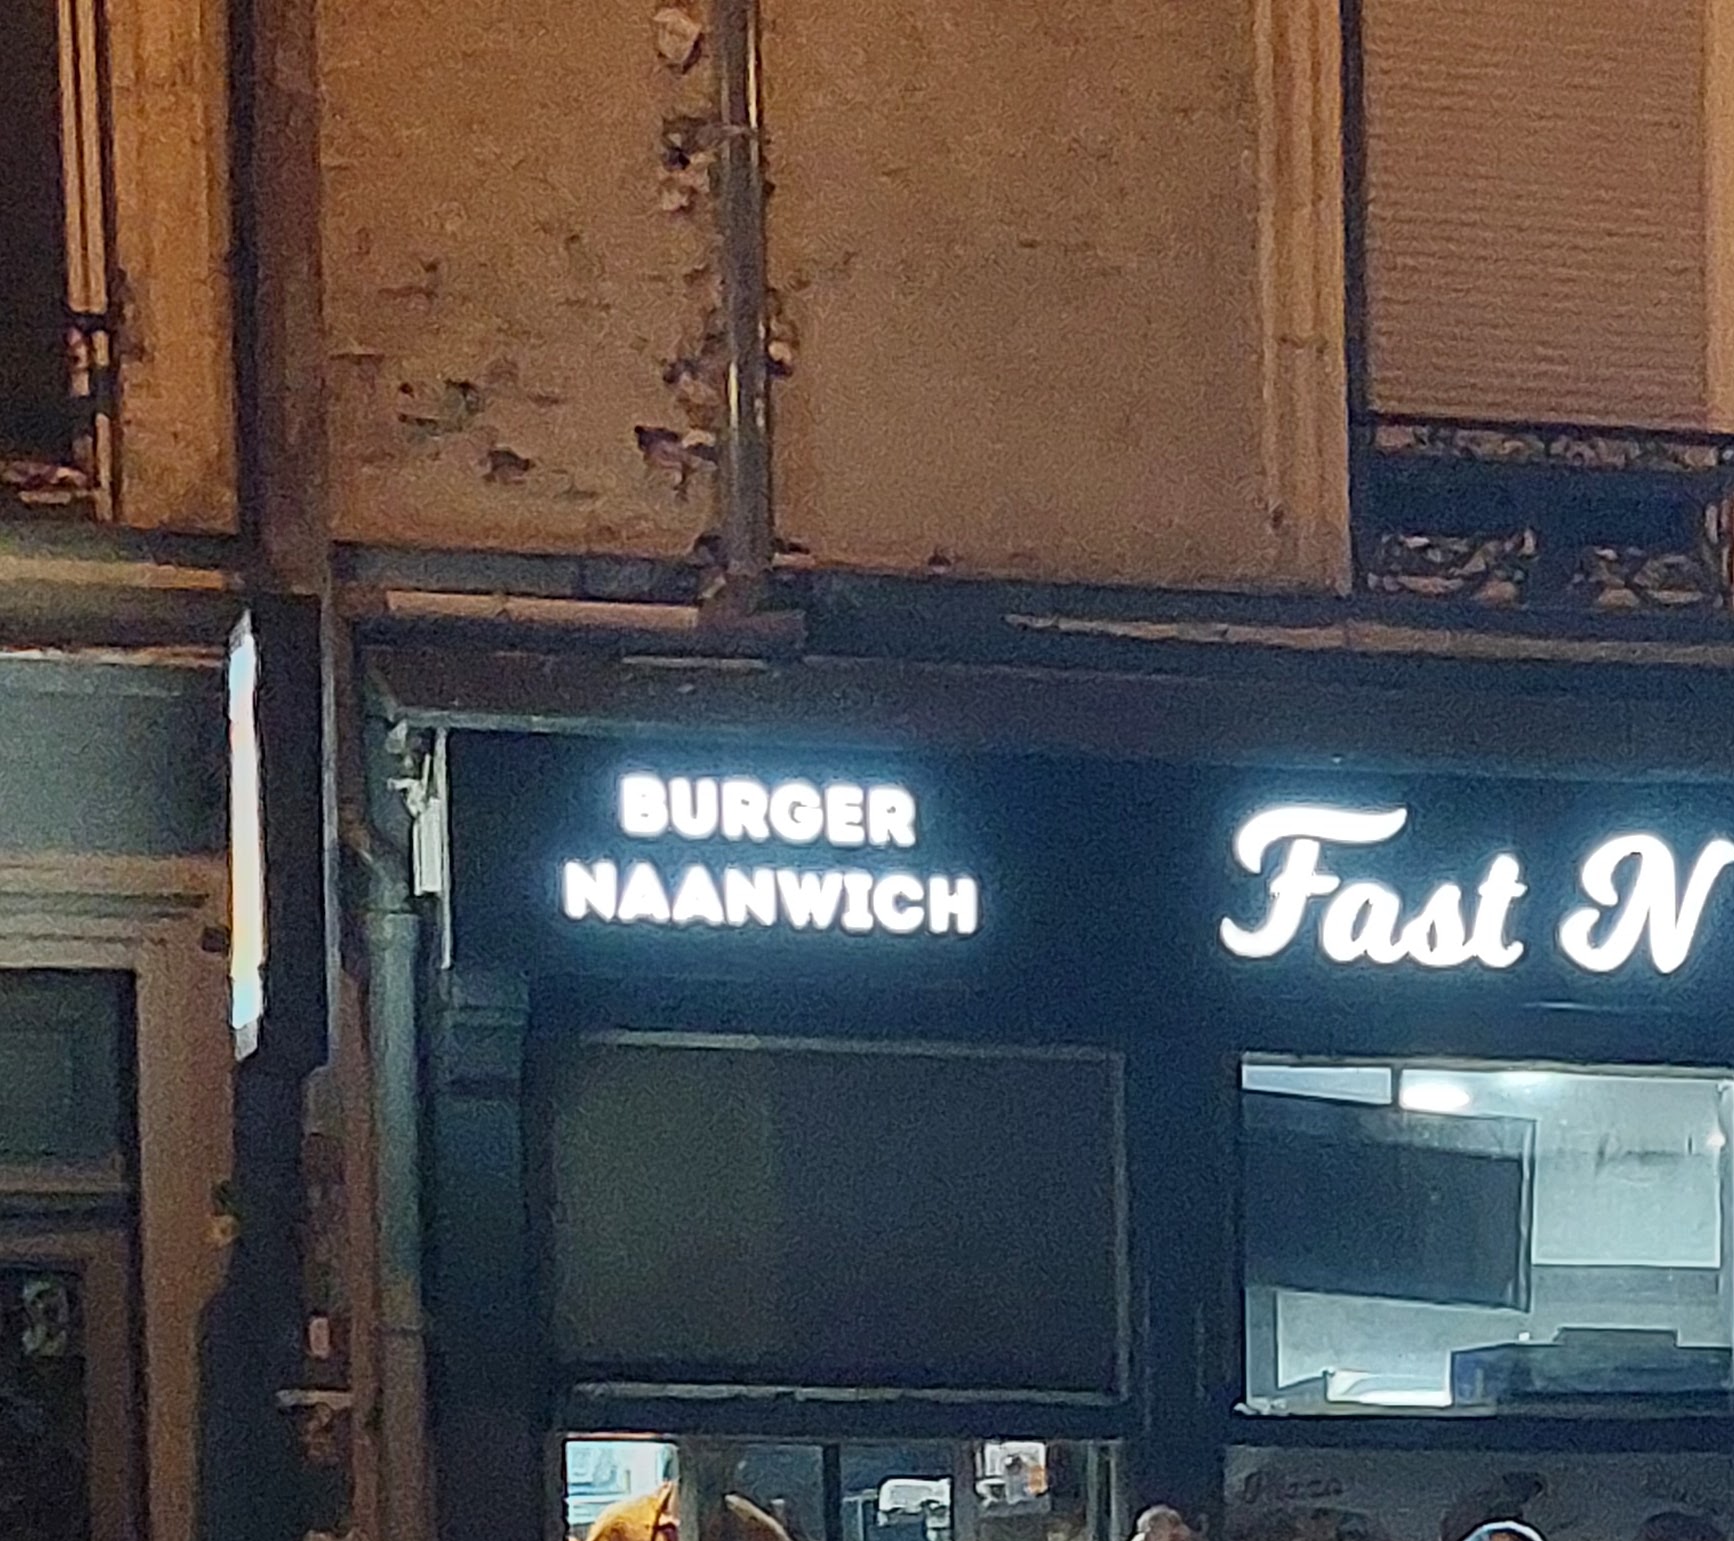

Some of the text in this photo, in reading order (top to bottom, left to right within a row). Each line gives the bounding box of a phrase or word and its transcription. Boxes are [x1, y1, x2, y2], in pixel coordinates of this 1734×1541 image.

[619, 772, 916, 847] BURGER
[562, 858, 978, 935] NAANWICH
[1220, 803, 1528, 968] Fast
